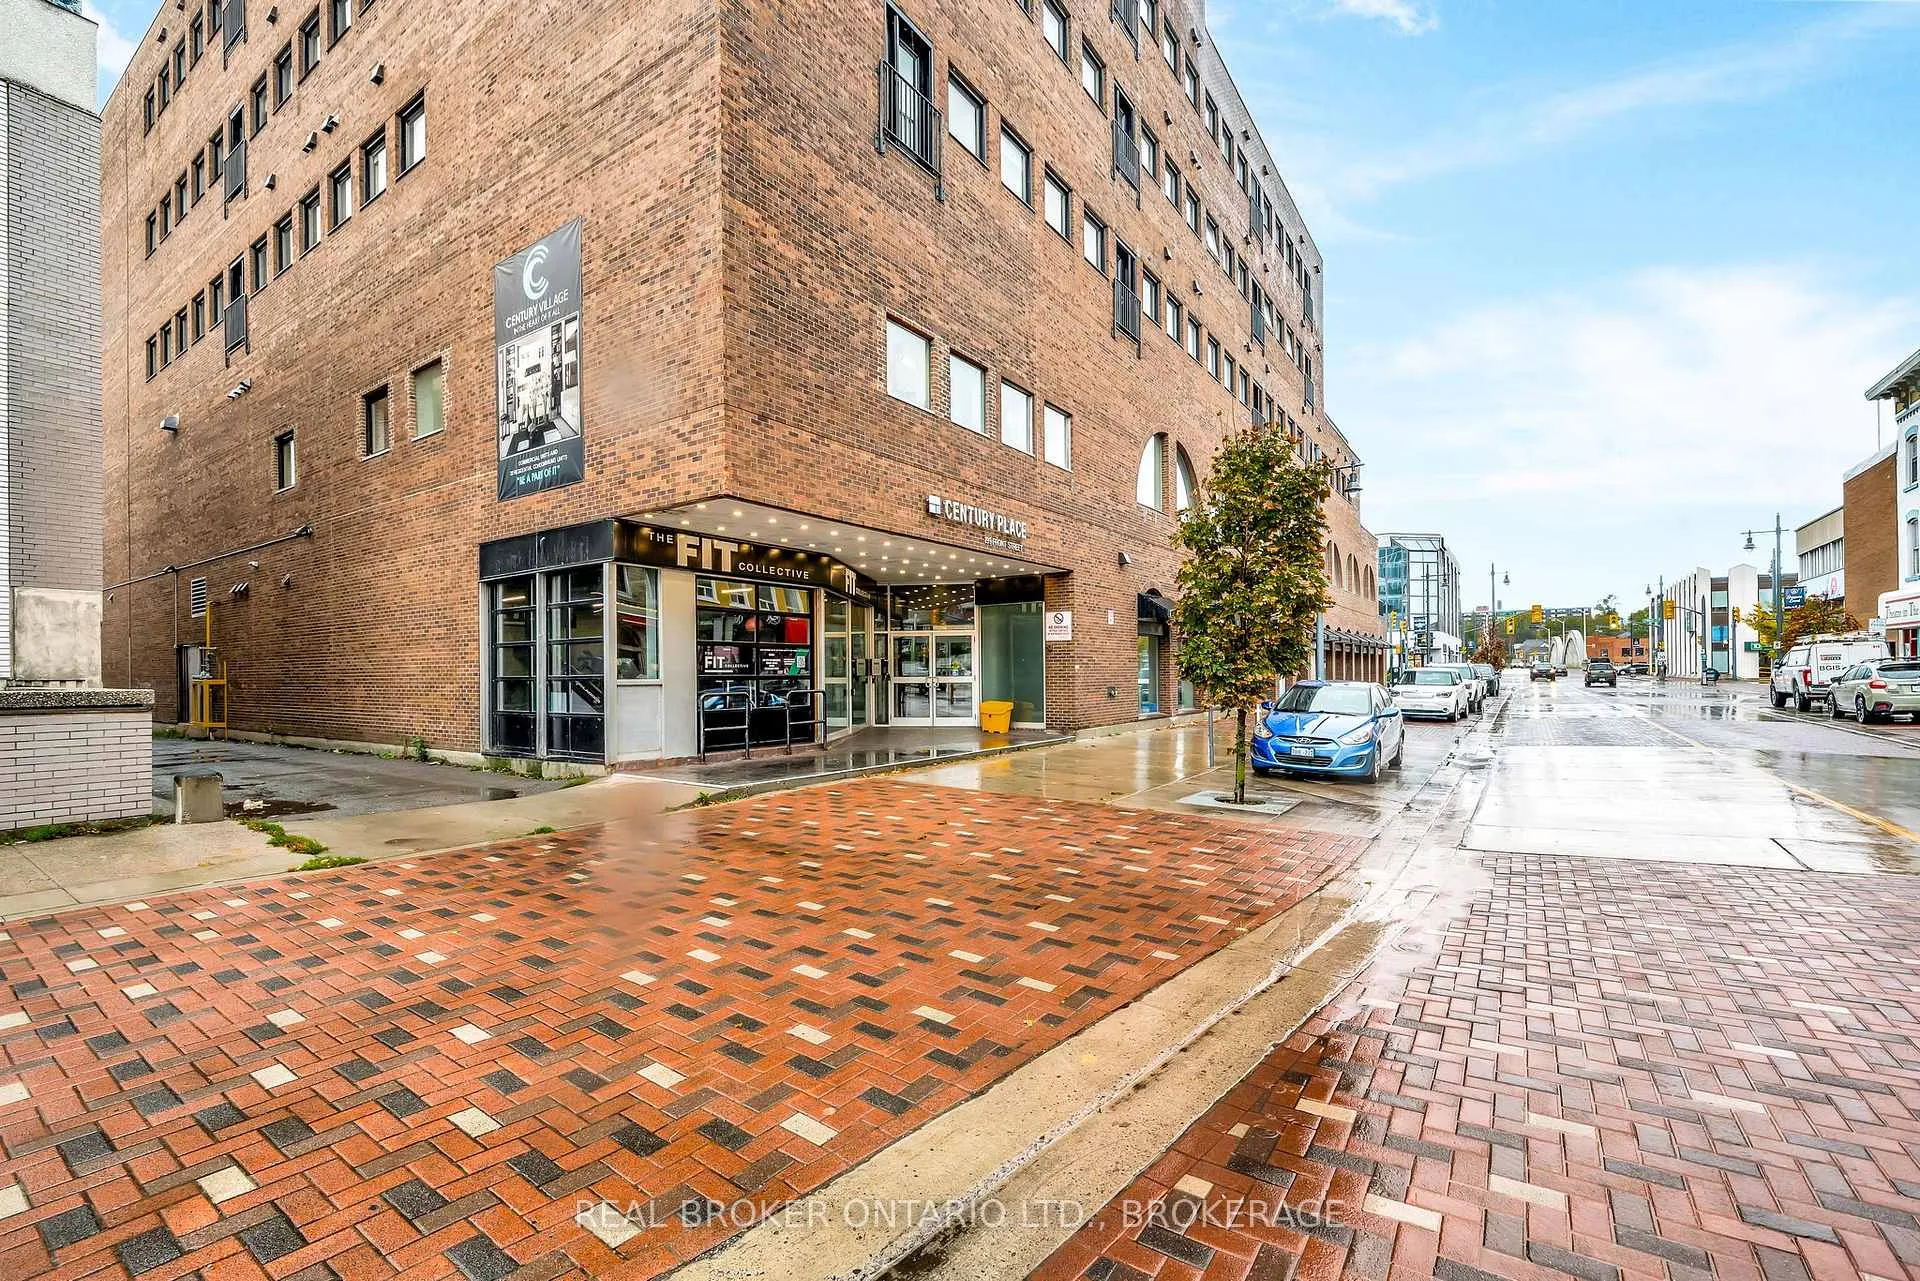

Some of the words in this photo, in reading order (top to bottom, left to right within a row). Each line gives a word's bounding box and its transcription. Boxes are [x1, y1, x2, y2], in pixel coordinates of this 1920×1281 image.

[506, 303, 538, 328] CENTURY
[538, 288, 569, 313] VILLAGE
[943, 500, 996, 530] CENTURY
[997, 514, 1028, 539] PLACE
[648, 531, 674, 544] THE
[676, 533, 739, 573] FIT
[738, 561, 810, 580] COLLECTIVE
[846, 568, 857, 596] FIT
[705, 656, 726, 669] FIT
